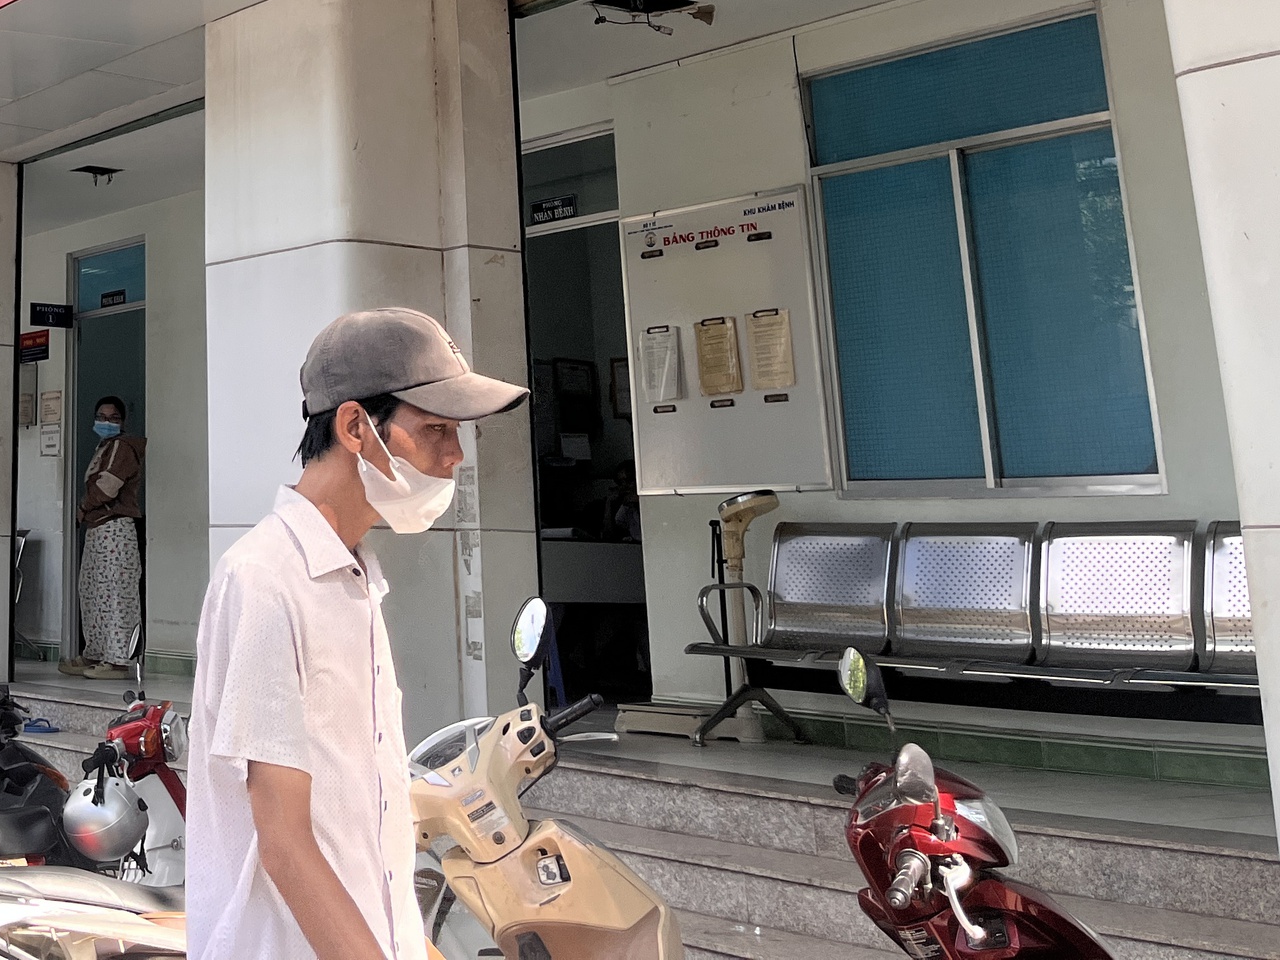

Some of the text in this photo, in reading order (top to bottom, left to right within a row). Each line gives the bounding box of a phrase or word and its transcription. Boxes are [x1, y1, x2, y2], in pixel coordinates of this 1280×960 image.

[743, 200, 795, 216] KHU KHÁM BỆNH
[663, 222, 758, 246] BẢNG THÔNG TIN
